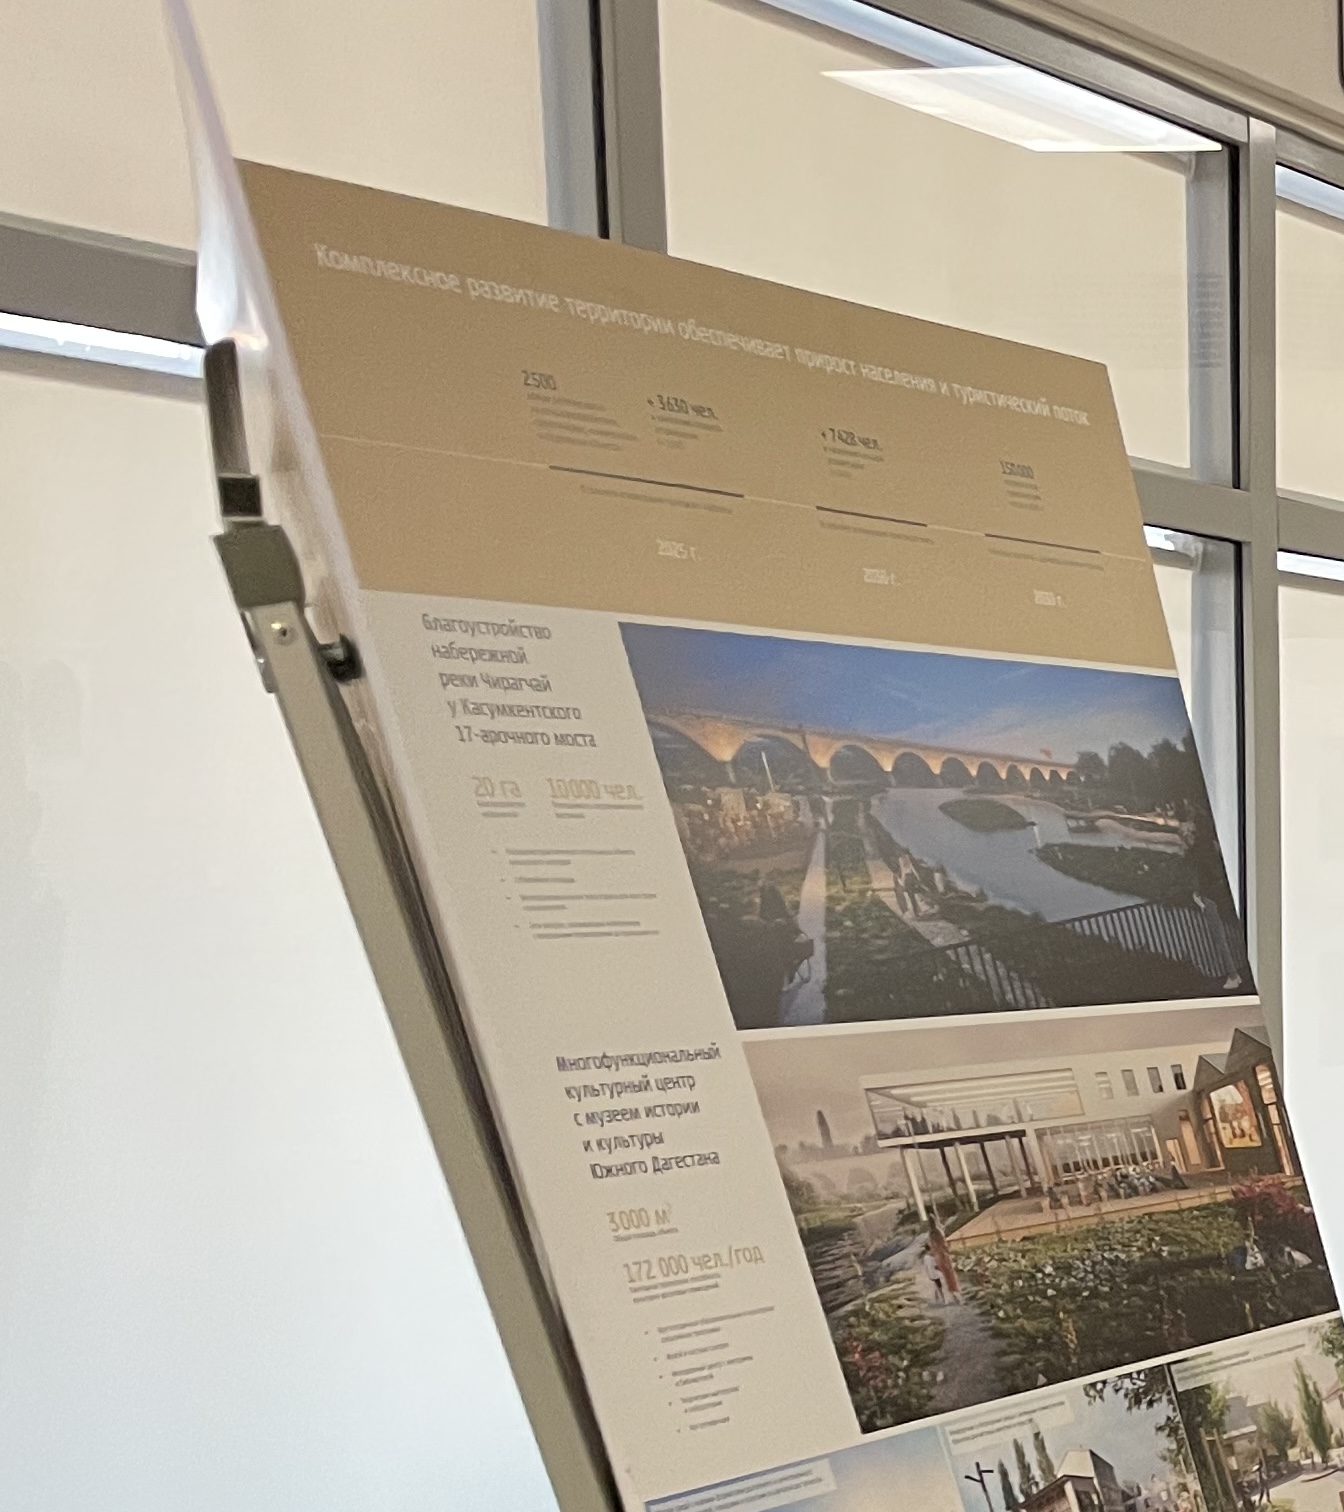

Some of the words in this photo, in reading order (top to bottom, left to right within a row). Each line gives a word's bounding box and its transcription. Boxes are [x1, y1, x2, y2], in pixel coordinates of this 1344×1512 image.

[314, 243, 462, 294] Комплексное
[467, 276, 560, 314] развитие
[564, 296, 675, 337] территории
[678, 317, 791, 363] обеспечивает
[795, 346, 857, 377] прирост
[861, 363, 937, 395] населения
[952, 382, 1051, 418] туристический
[1052, 404, 1091, 427] поток
[431, 641, 529, 664] набережной
[439, 672, 479, 690] реки
[480, 672, 552, 692] Чирагчай
[447, 699, 457, 719] у
[462, 699, 582, 720] Касумкентского
[455, 725, 551, 746] 17-арочного
[553, 731, 597, 748] моста
[556, 1042, 722, 1072] Многофункциональный
[564, 1074, 653, 1103] культурный
[655, 1074, 696, 1093] центр
[574, 1111, 583, 1127] с
[585, 1106, 641, 1128] музеем
[643, 1099, 700, 1120] истории
[582, 1139, 594, 1152] и
[596, 1131, 665, 1154] культуры
[589, 1159, 649, 1179] Южного
[651, 1150, 721, 1175] Дагестана
